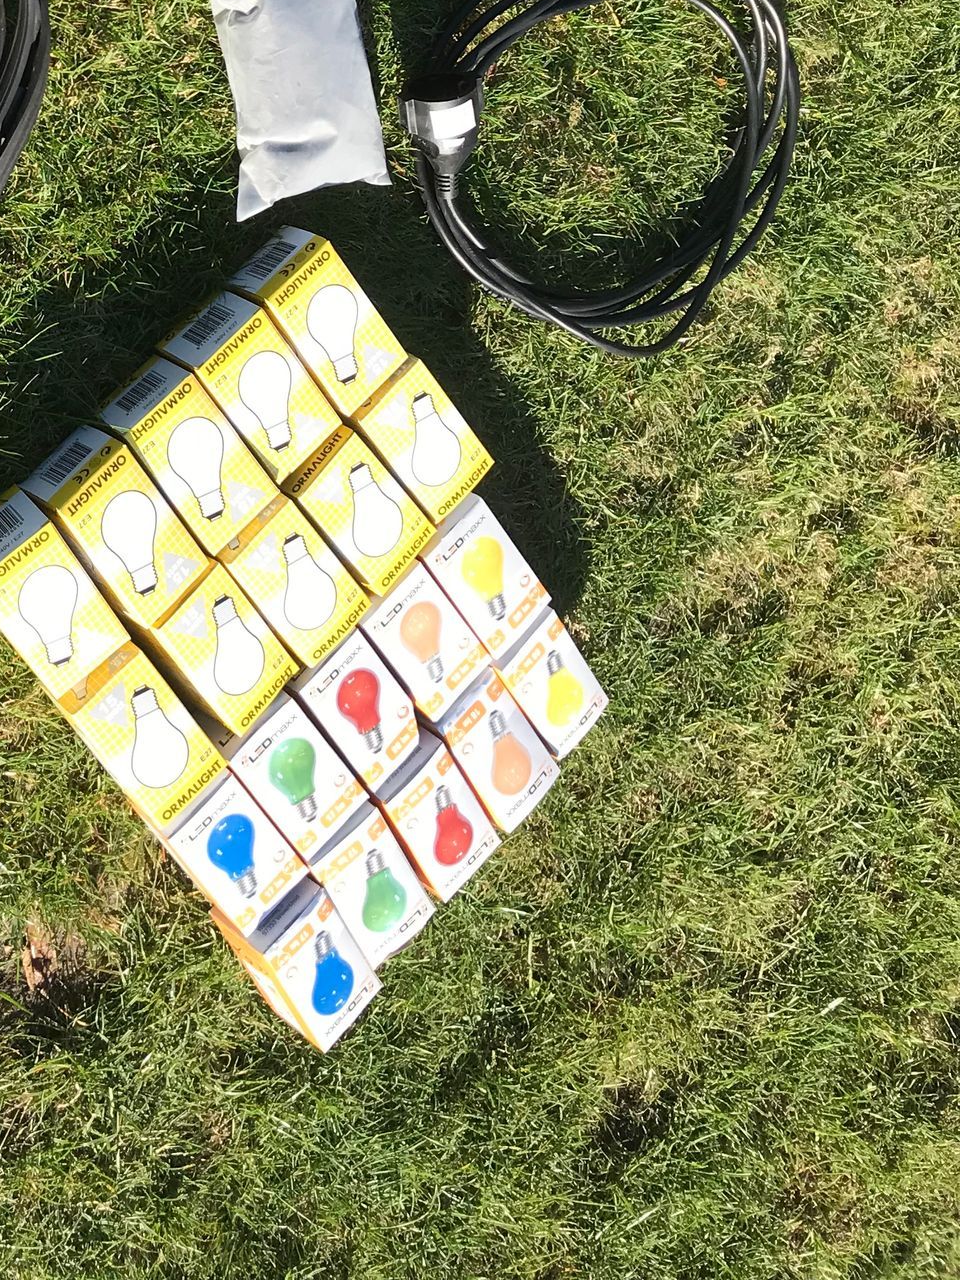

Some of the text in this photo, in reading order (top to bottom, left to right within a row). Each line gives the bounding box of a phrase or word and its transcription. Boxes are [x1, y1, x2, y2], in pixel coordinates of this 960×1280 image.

[273, 249, 331, 306] ORMALIGHT
[203, 316, 263, 376] ORMALIGHT
[129, 381, 193, 441] ORMALIGHT
[65, 453, 128, 516] ORMALIGHT
[289, 431, 343, 494] ORMALIGHT
[436, 458, 491, 516] ORMALIGHT
[379, 526, 433, 588] ORMALIGHT
[311, 599, 368, 660] ORMALIGHT
[238, 664, 296, 728] ORMALIGHT
[160, 759, 223, 821] ORMALIGHT
